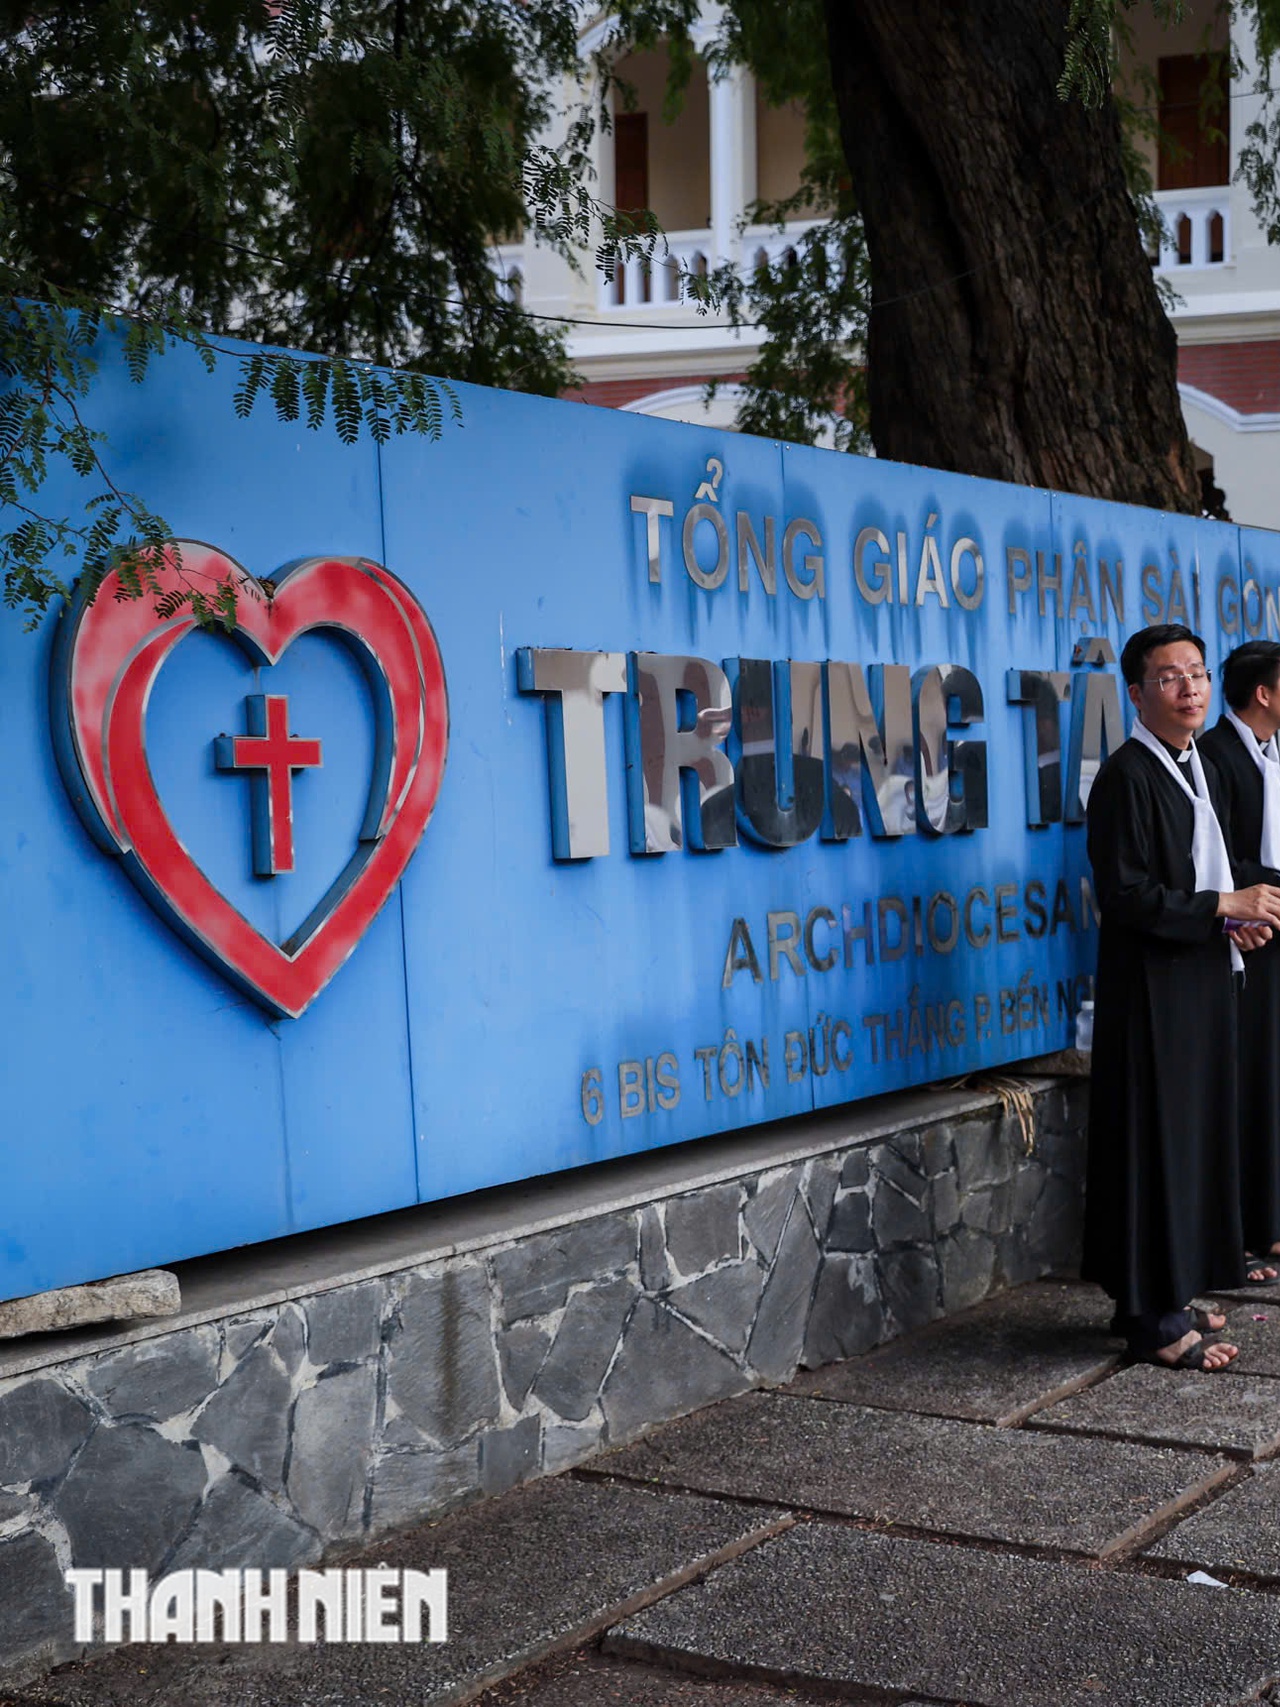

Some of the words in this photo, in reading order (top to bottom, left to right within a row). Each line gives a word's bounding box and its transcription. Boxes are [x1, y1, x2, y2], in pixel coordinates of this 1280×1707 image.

[629, 457, 826, 600] TỔNG
[854, 512, 985, 611] GIÁO
[1006, 539, 1125, 636] PHẬN
[1141, 550, 1201, 632] SÀI
[517, 648, 990, 860] TRUNG
[1006, 637, 1128, 829] TÂ
[721, 876, 1102, 989] ARCHDIOCESAN
[580, 1069, 604, 1126] 6
[618, 1052, 681, 1119] BIS
[694, 1027, 770, 1101] TÔN
[784, 1012, 853, 1084] ĐỨC
[863, 983, 966, 1066] THẮNG
[999, 968, 1049, 1036] BẾN
